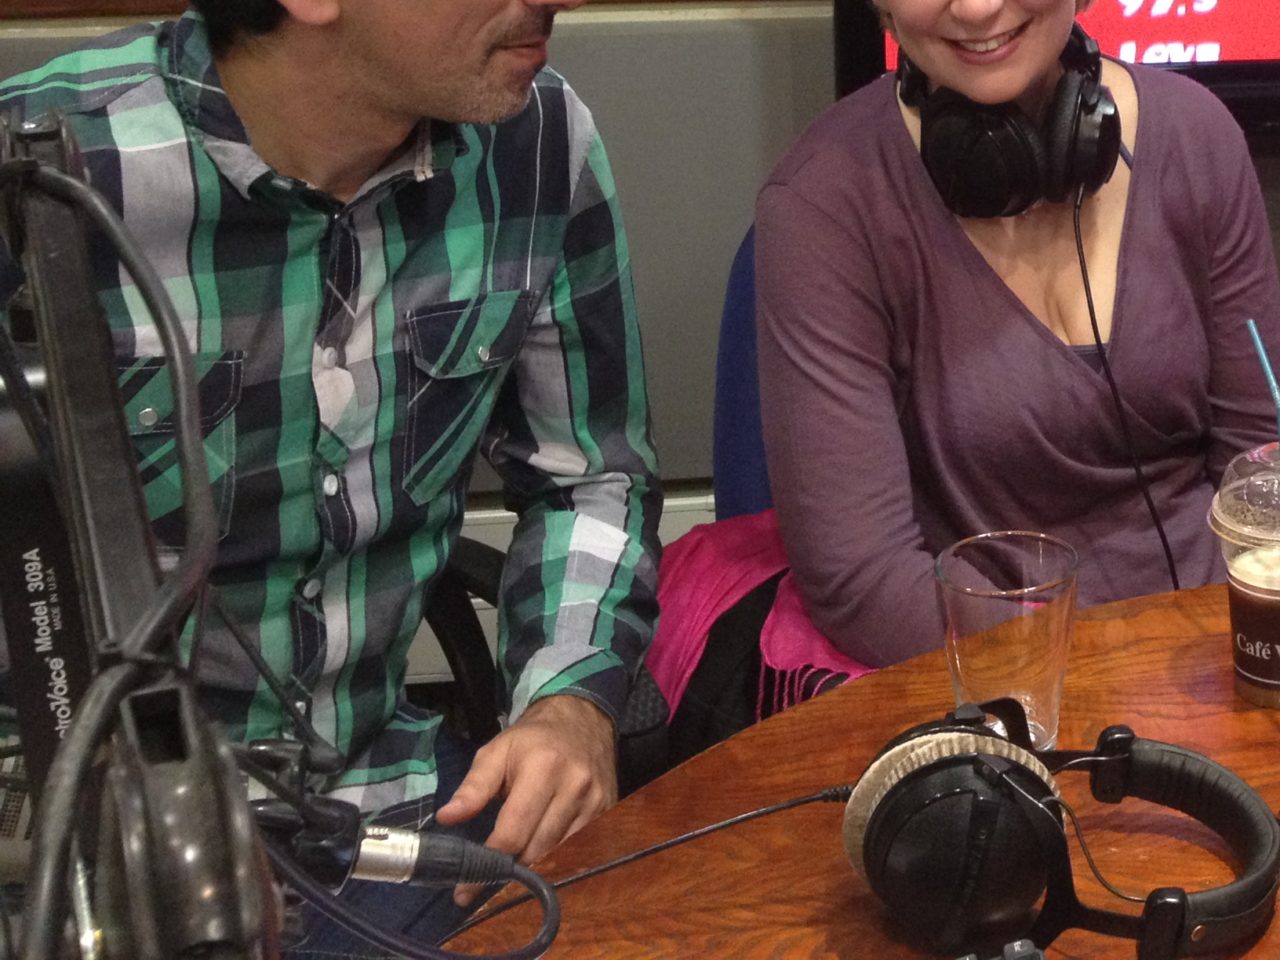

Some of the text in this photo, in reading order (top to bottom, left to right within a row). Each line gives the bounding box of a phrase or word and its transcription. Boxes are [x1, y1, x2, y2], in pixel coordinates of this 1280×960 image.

[21, 547, 53, 652] Model 309A
[1236, 633, 1271, 660] Café
